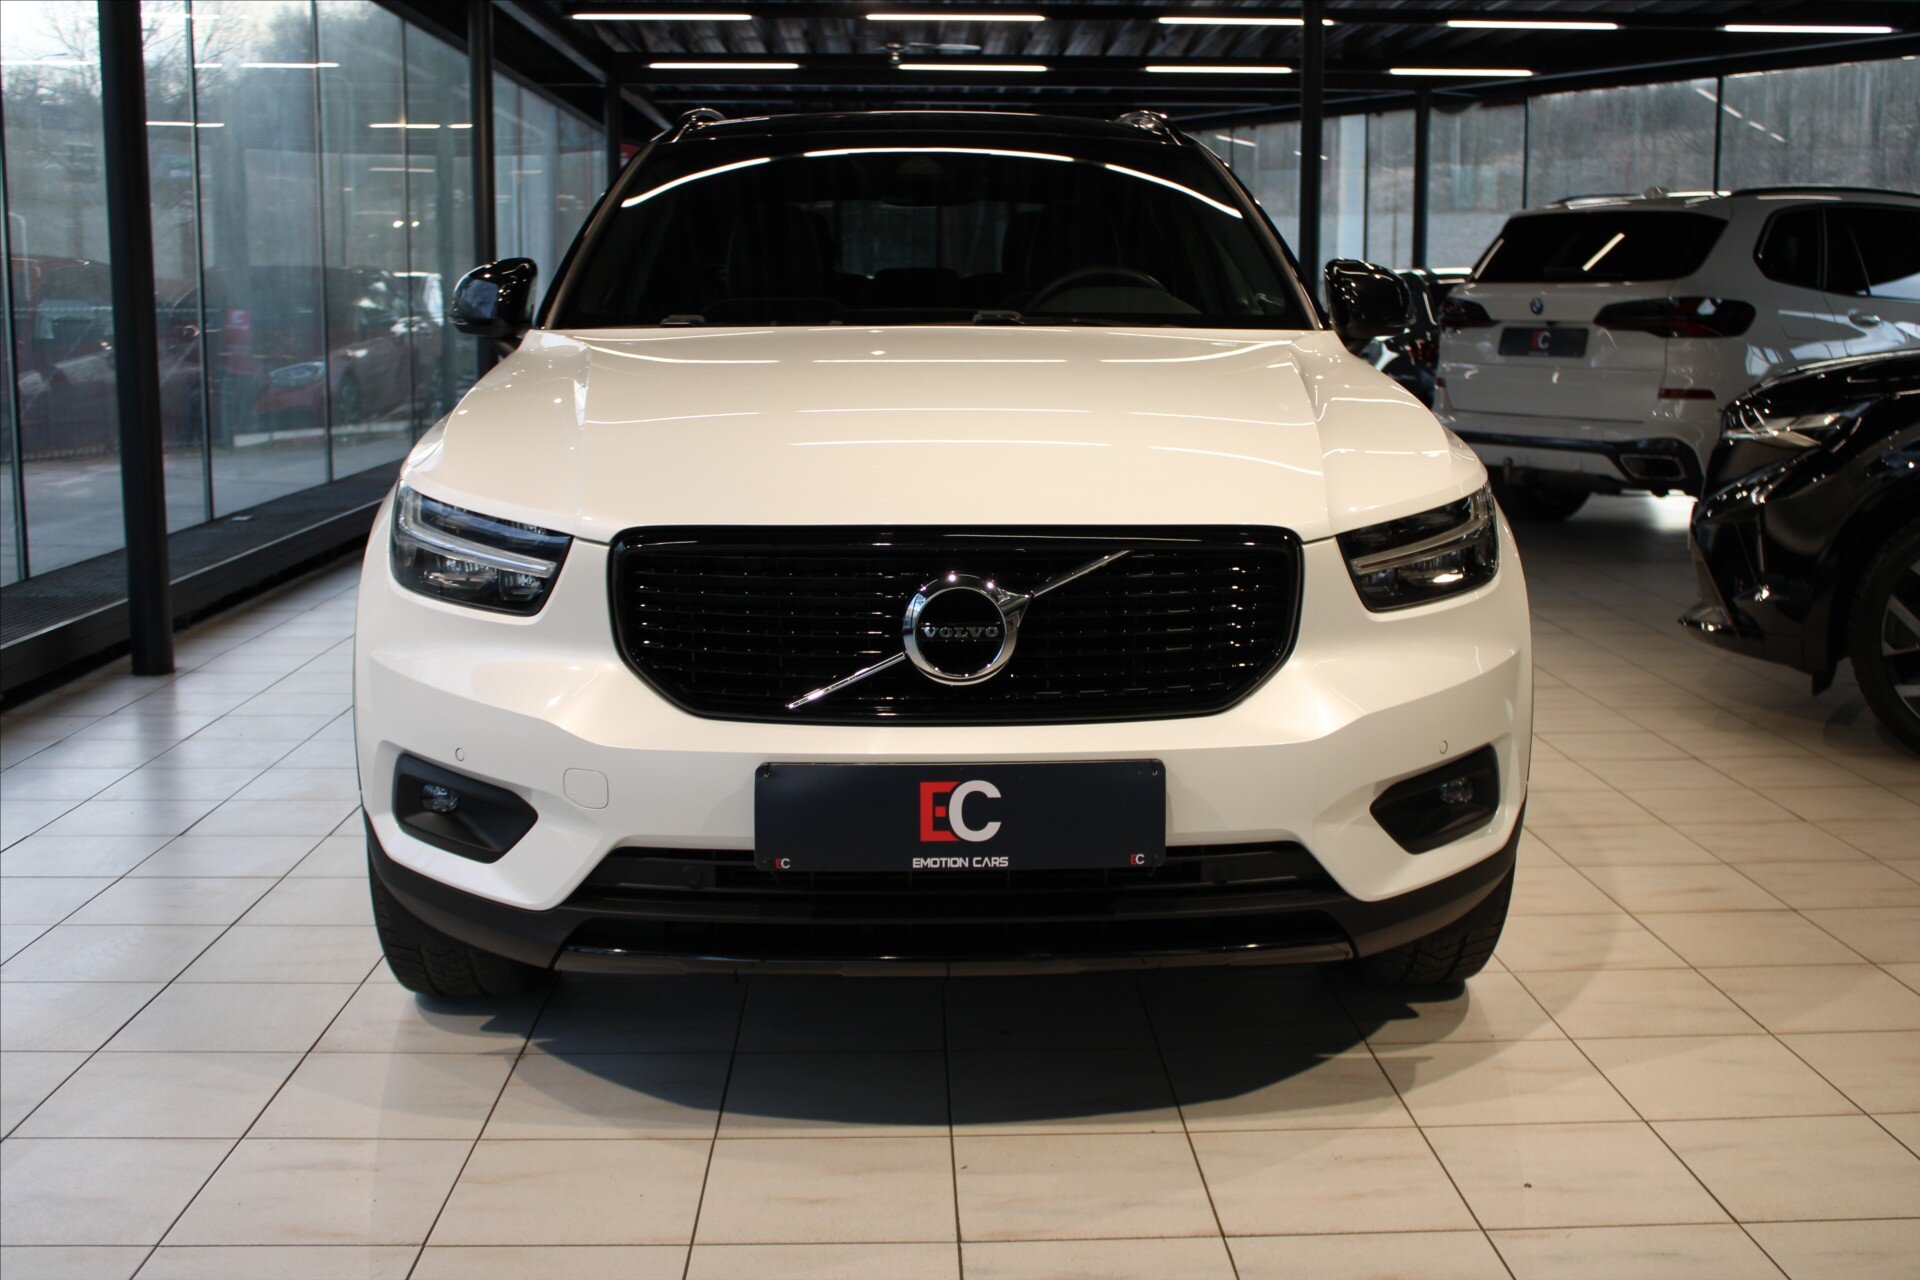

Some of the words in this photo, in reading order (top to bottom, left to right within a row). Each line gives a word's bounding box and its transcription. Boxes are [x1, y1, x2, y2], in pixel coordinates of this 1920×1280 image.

[921, 626, 999, 638] VOLVO
[920, 780, 1002, 842] EC
[912, 857, 969, 868] EMOTION
[972, 857, 1009, 868] CARS
